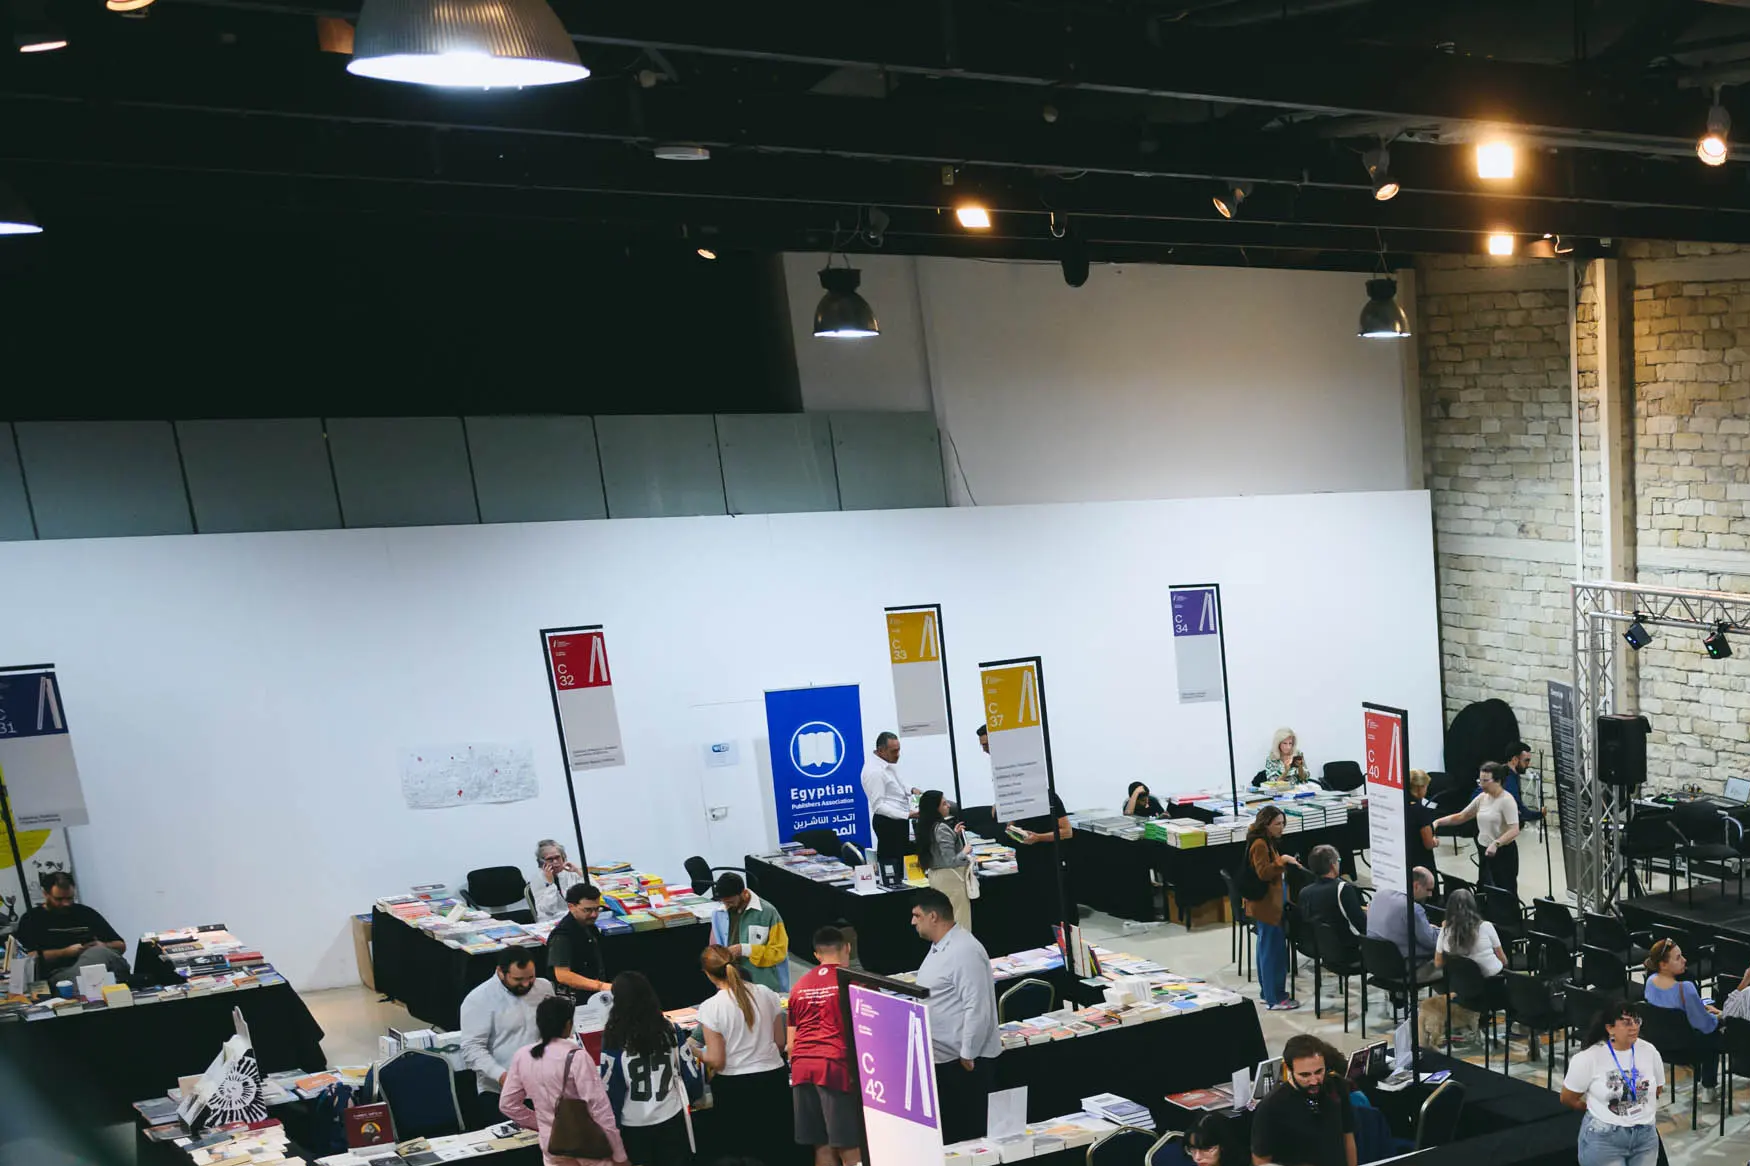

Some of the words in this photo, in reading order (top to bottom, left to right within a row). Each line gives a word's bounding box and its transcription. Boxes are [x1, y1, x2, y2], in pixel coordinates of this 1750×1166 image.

[1175, 615, 1183, 623] C
[1175, 624, 1188, 633] 34
[892, 640, 901, 649] C
[893, 650, 907, 660] 33
[557, 663, 567, 674] C
[560, 675, 574, 686] 32
[988, 702, 998, 713] C
[990, 714, 1004, 727] 37
[1368, 751, 1375, 763] C
[1368, 765, 1380, 779] 40
[790, 783, 853, 802] Egyptian
[791, 801, 821, 810] Publishers
[821, 798, 855, 807] Association
[861, 1052, 876, 1075] C
[865, 1078, 887, 1104] 42
